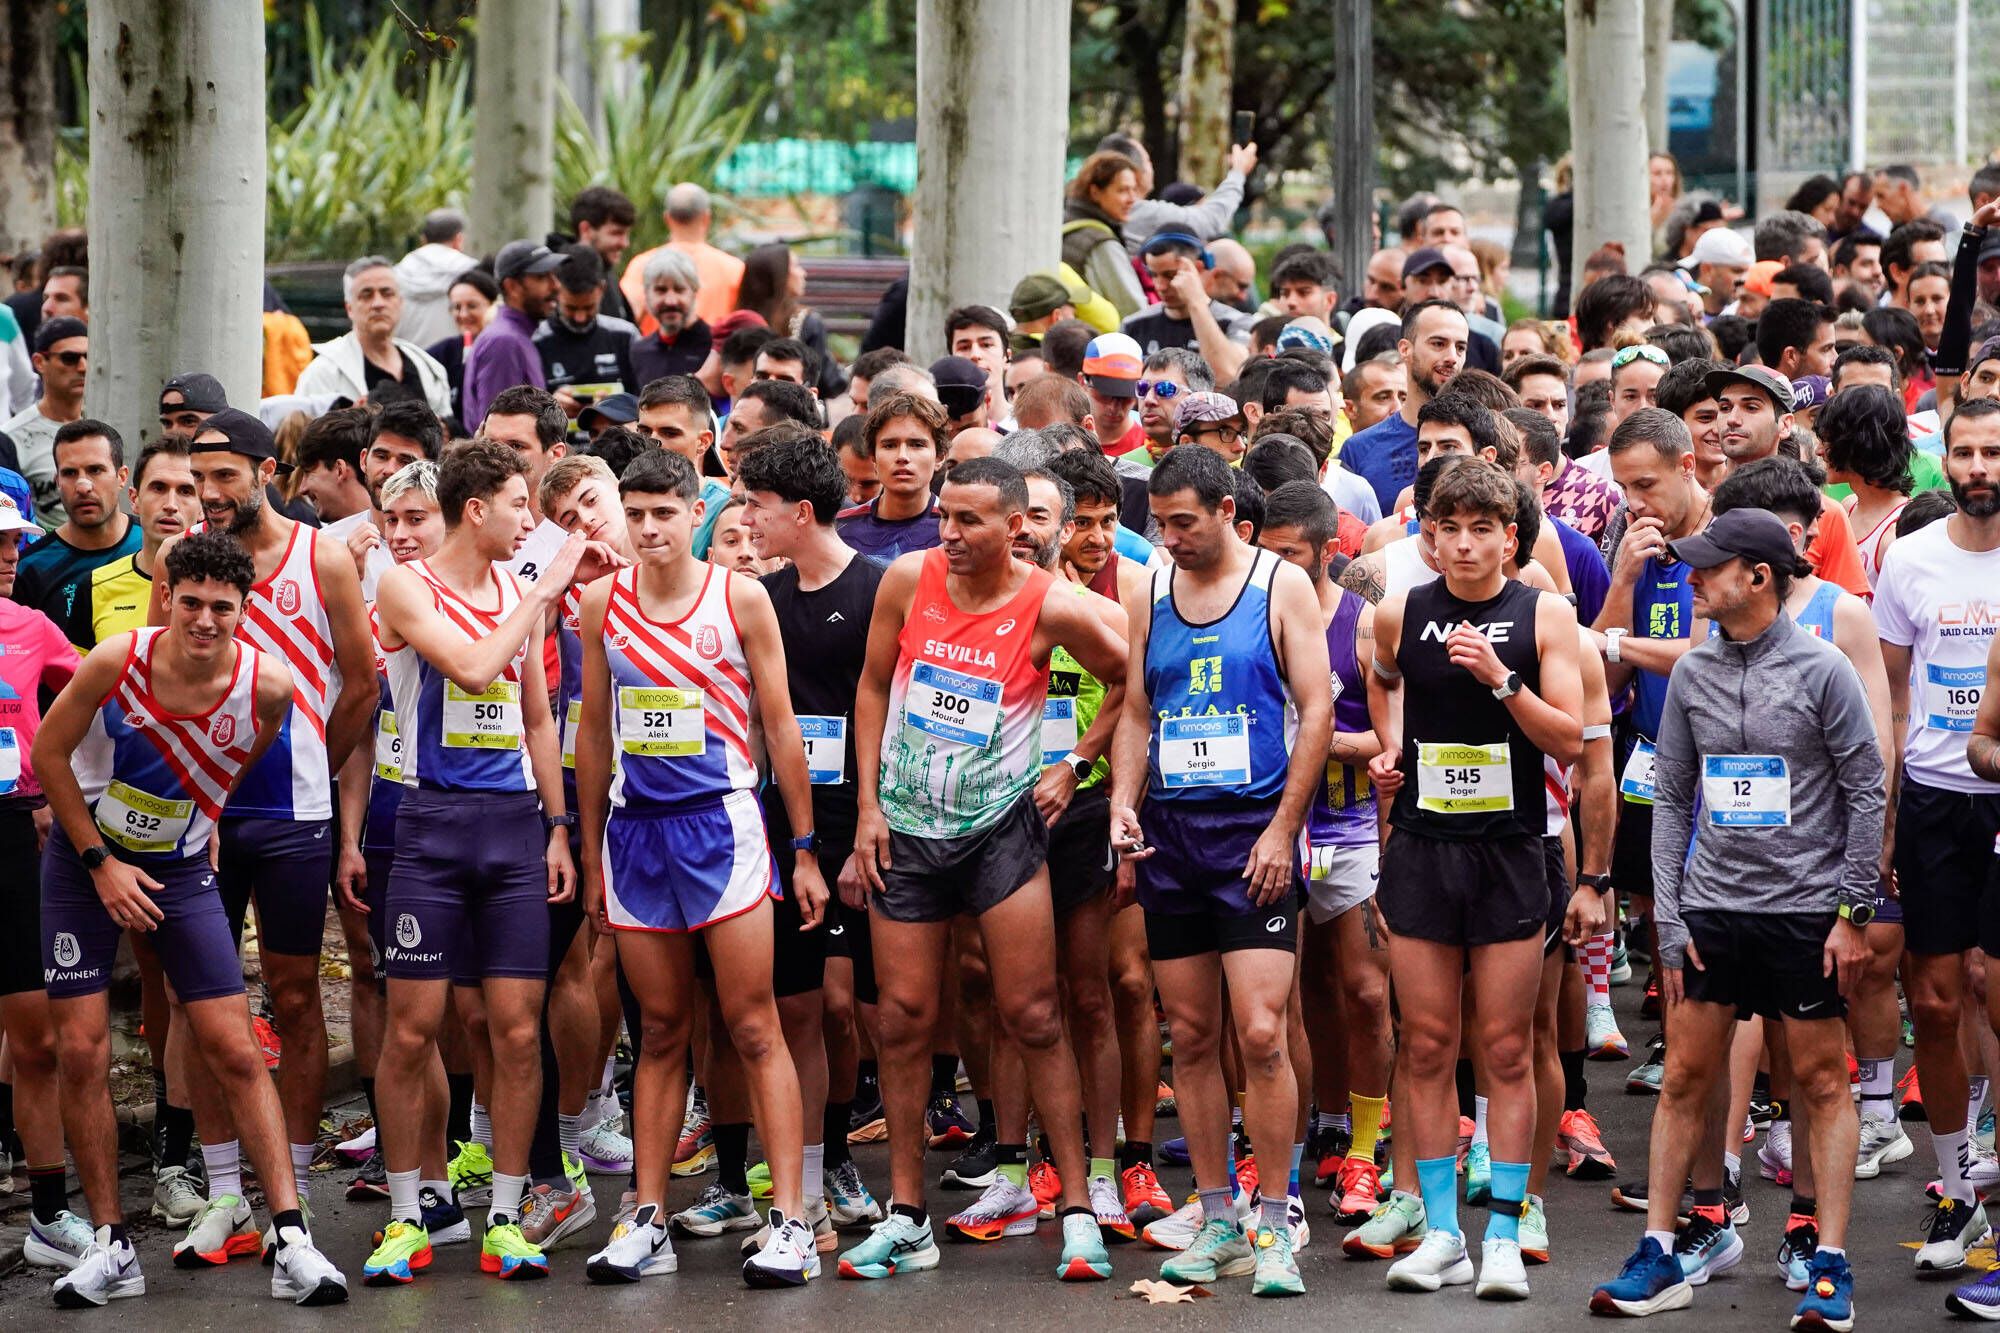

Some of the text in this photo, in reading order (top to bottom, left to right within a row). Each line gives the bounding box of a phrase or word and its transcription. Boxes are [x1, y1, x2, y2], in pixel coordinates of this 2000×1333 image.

[1940, 628, 1961, 637] RAID
[1963, 627, 1980, 636] CAL
[923, 639, 996, 669] SEVILLA
[935, 671, 979, 692] inmoovs
[1942, 670, 1985, 681] inmoovs
[637, 693, 679, 703] inmoovs
[931, 691, 970, 714] 300
[1947, 688, 1980, 705] 160
[475, 704, 503, 720] 501
[931, 710, 965, 725] Mourad
[476, 722, 502, 730] Yassin
[643, 711, 672, 728] 521
[828, 721, 838, 730] 10
[1180, 721, 1222, 732] inmoovs
[648, 730, 669, 739] Aleix
[1193, 741, 1207, 756] 11
[1440, 749, 1484, 760] inmoovs
[1187, 759, 1216, 769] Sergio
[1723, 760, 1764, 772] inmoovs
[1445, 768, 1481, 784] 545
[1450, 787, 1477, 796] Roger
[1733, 780, 1751, 796] 12
[128, 791, 171, 812] inmoovs
[1732, 800, 1752, 808] Jose
[126, 810, 161, 831] 632
[125, 826, 152, 839] Roger
